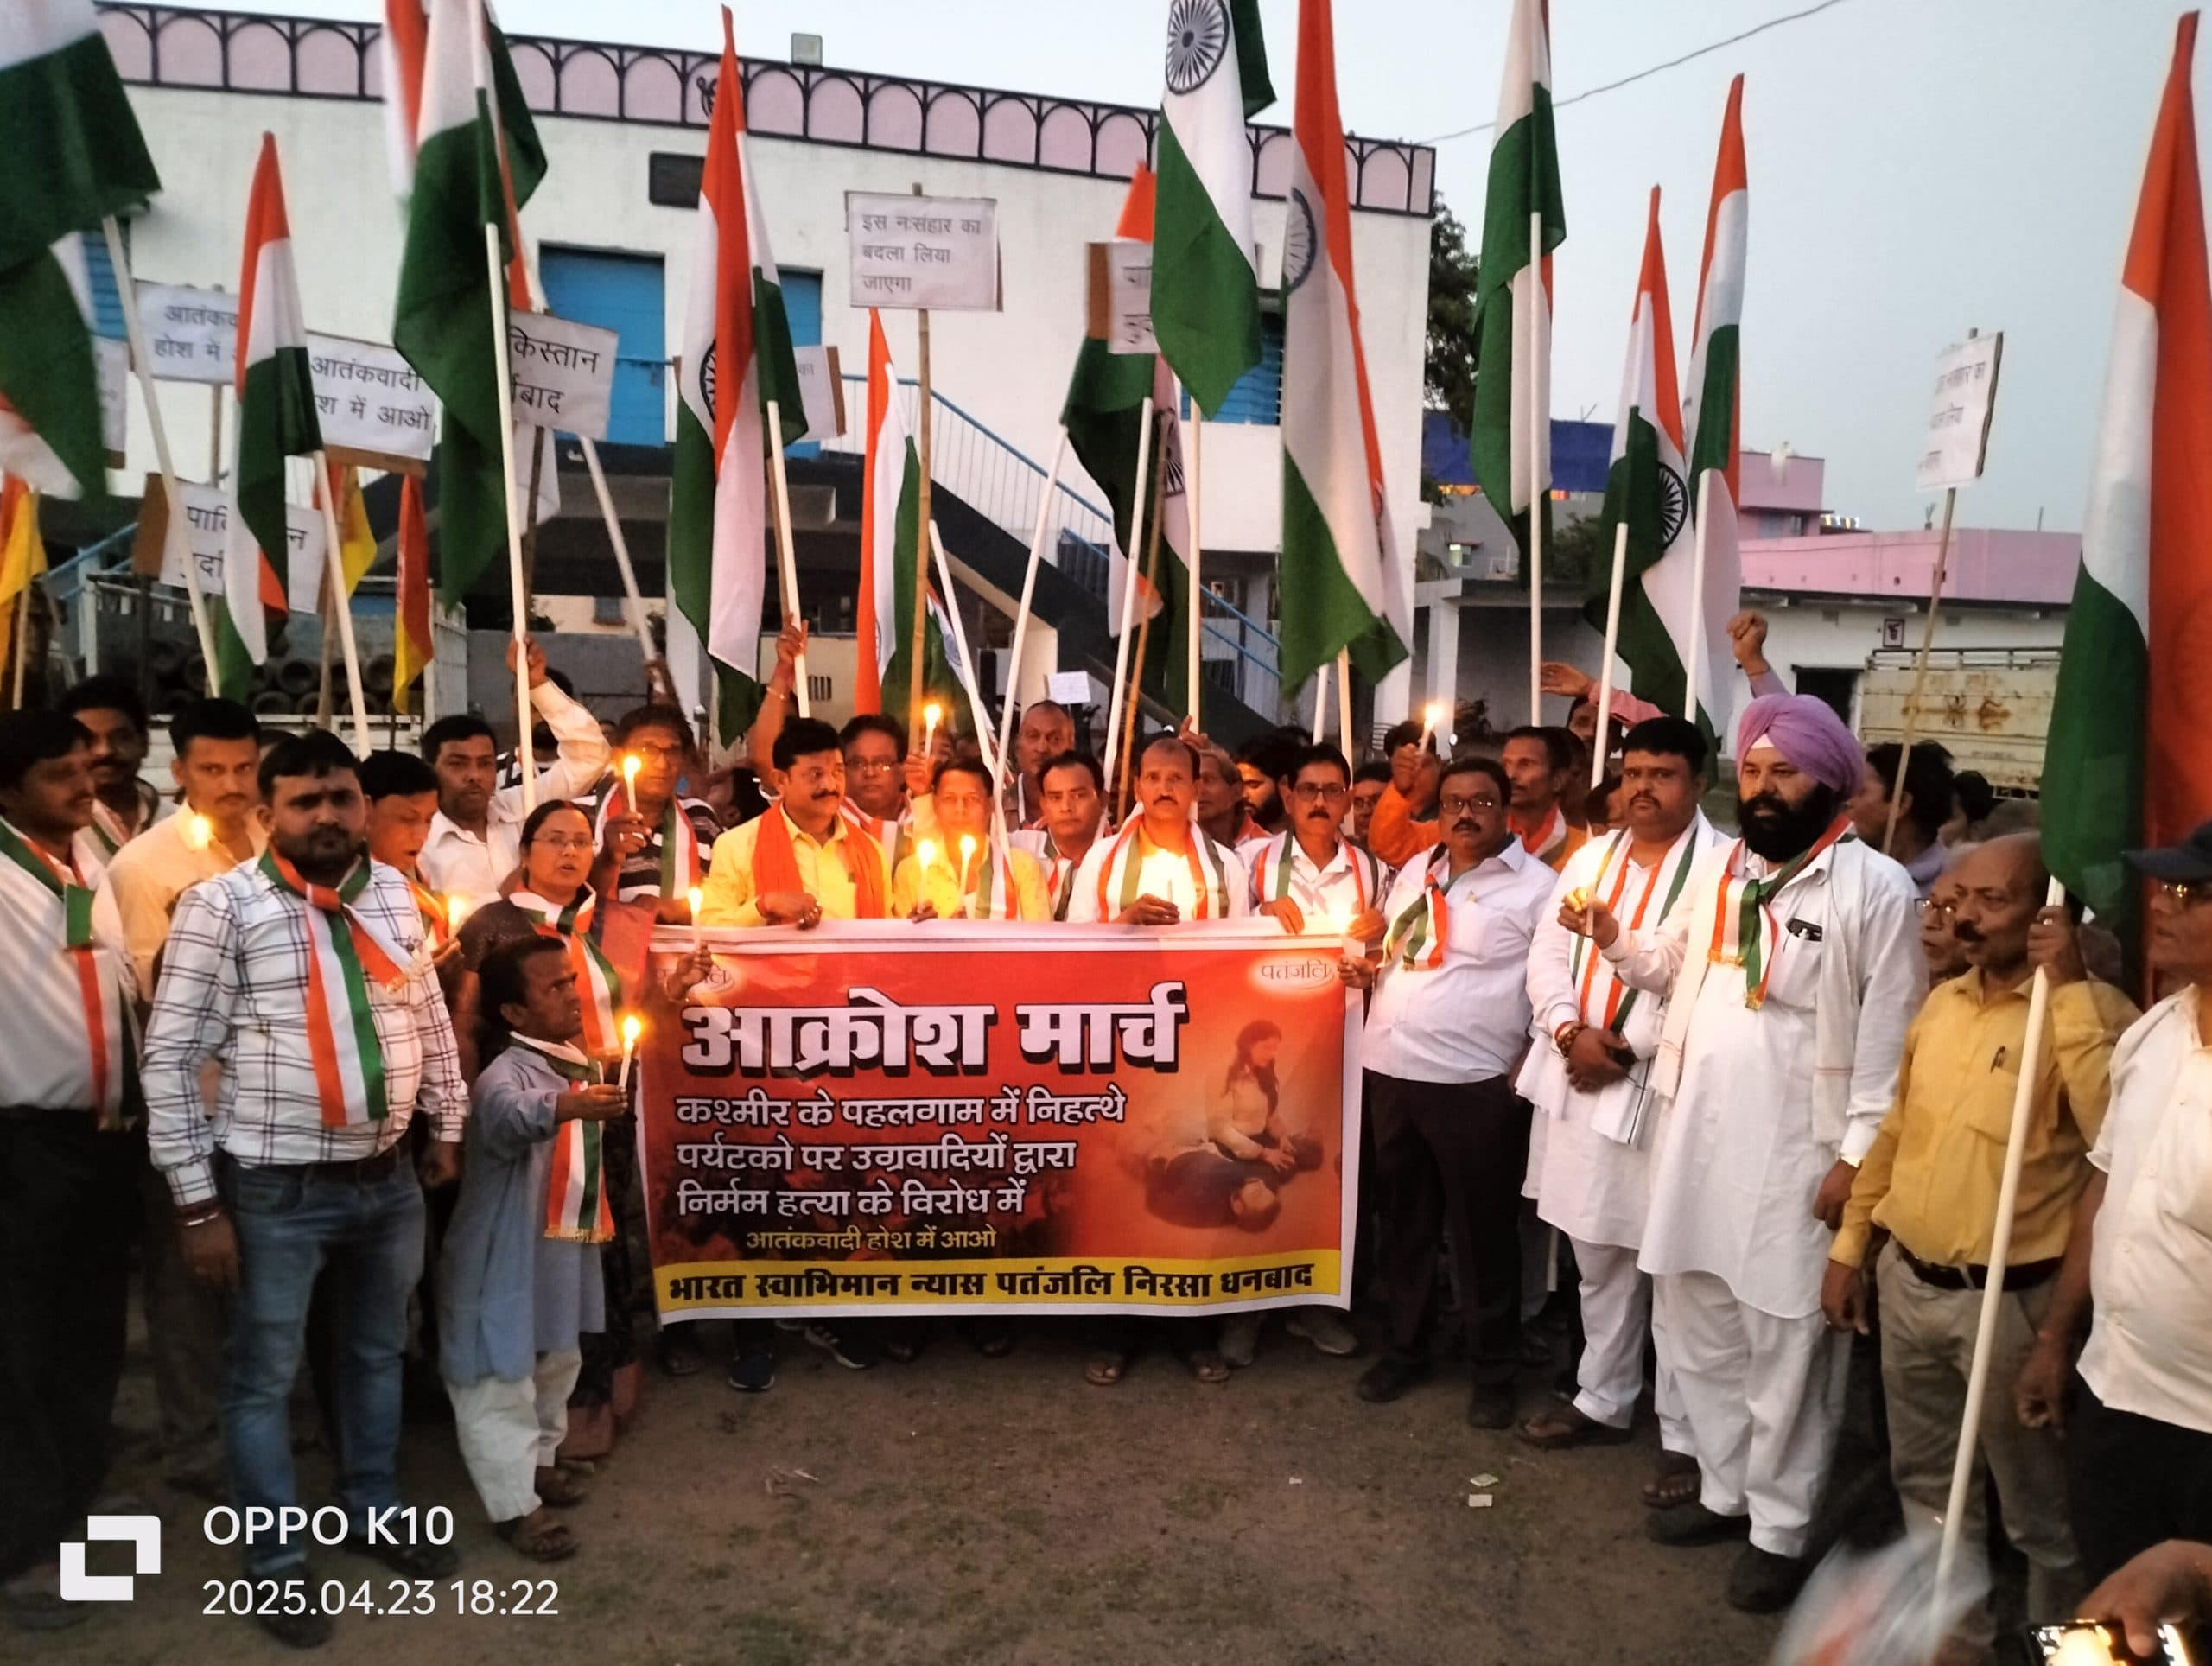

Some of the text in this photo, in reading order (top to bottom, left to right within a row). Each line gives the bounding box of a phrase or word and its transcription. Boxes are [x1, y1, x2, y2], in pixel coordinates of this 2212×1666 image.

[861, 214, 887, 232] इस
[961, 219, 981, 234] का
[862, 242, 951, 263] बदला लिया
[862, 275, 912, 293] जाएगा
[349, 396, 367, 420] में
[378, 404, 432, 431] आओ
[1262, 958, 1332, 980] पतंजलि
[681, 982, 1188, 1074] आक्रोश मार्च
[677, 1084, 1126, 1127] कश्मीर के पहलगाम में निहत्थे
[677, 1132, 1077, 1175] पर्यटको पर उग्रवादियों द्वारा
[677, 1177, 1027, 1217] निर्मम हत्या के विरोध में
[747, 1224, 997, 1250] आतंकवादी होश में आओ
[670, 1263, 1314, 1300] भारत स्वाभिमान न्यास पतंजलि निरसा धनबाद
